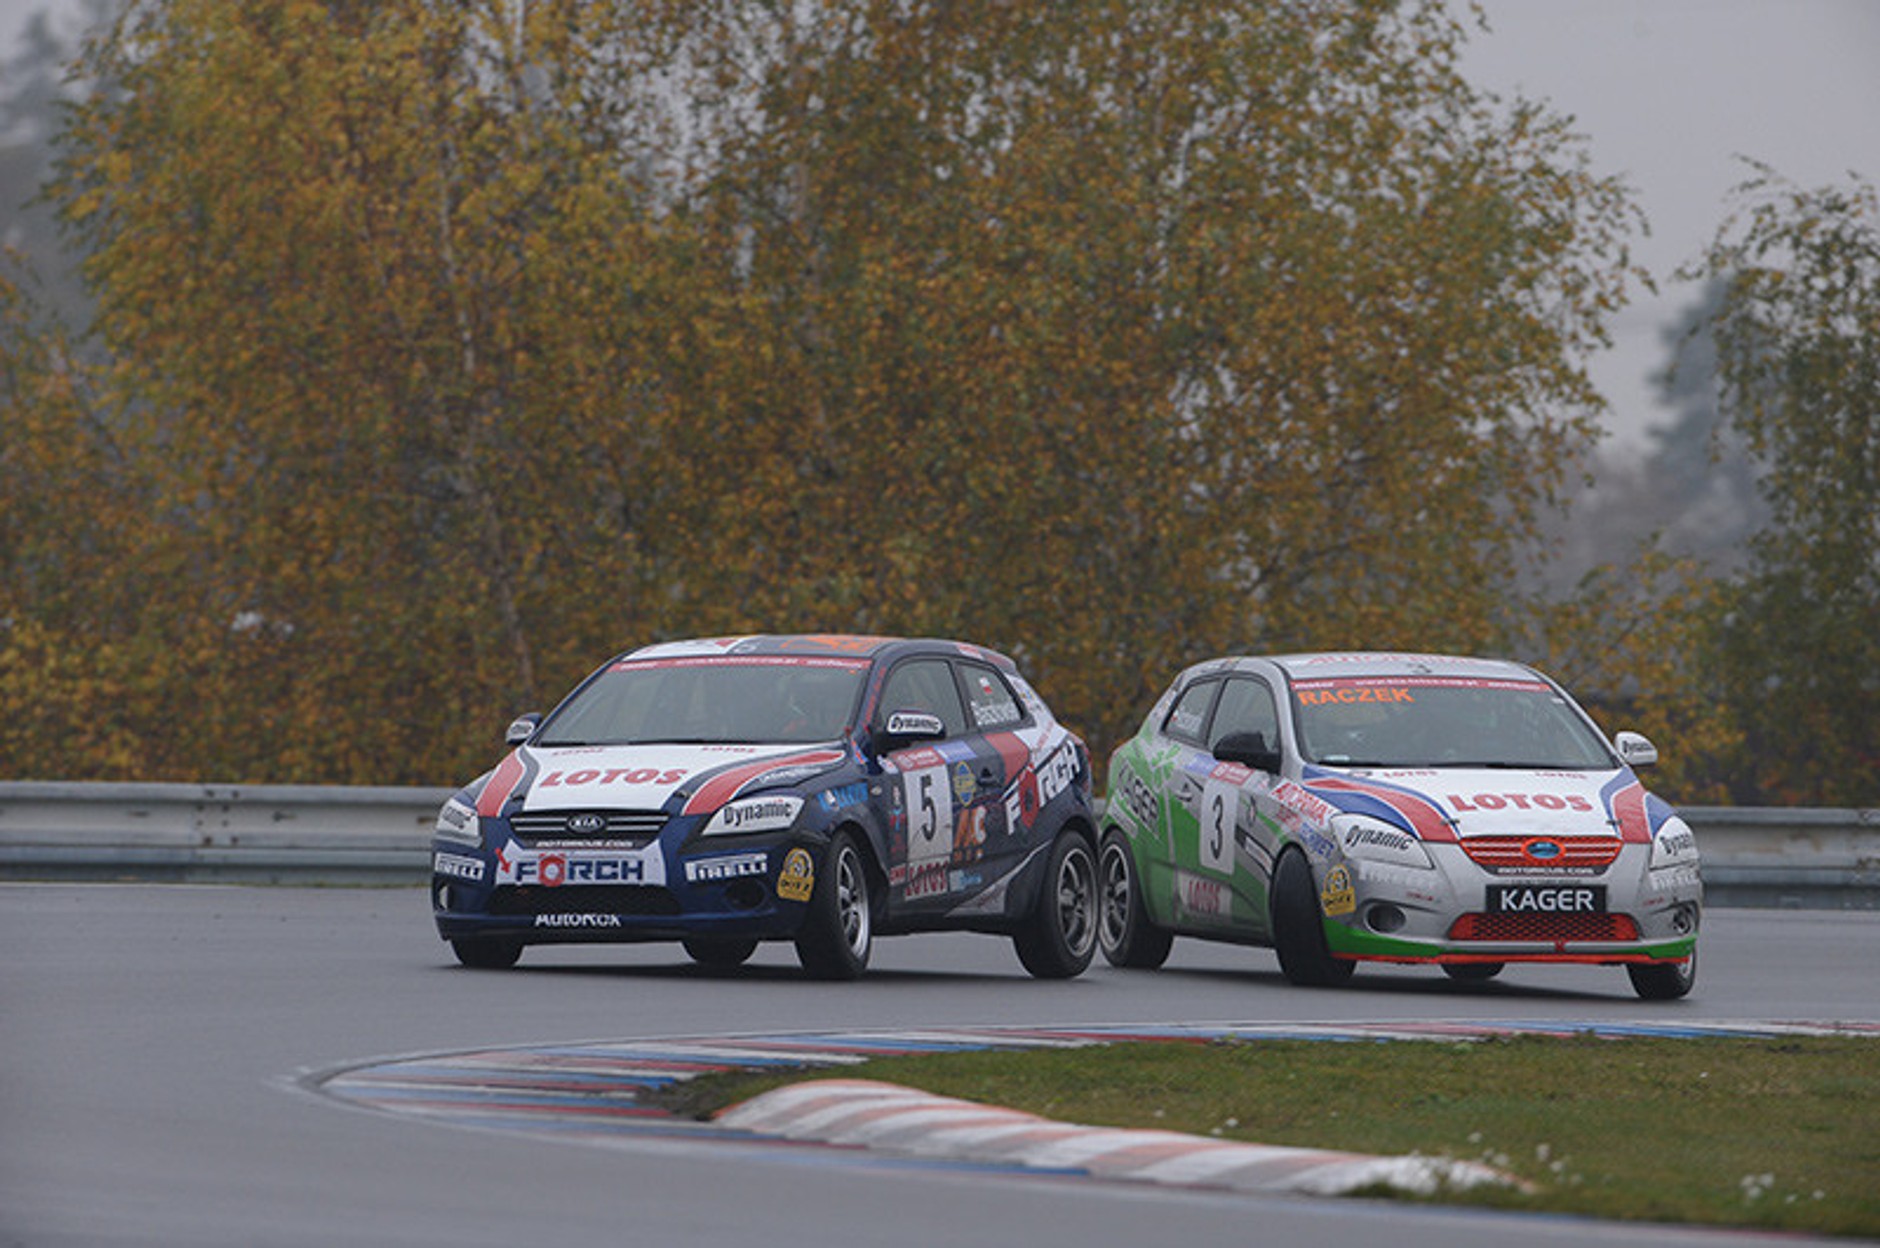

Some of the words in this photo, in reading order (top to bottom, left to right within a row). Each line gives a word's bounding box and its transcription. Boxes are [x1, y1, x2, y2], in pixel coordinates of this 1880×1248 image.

[1297, 686, 1415, 707] RACZEK
[539, 769, 688, 788] LOTOS
[723, 801, 793, 827] Dynamic
[920, 774, 937, 842] 5
[1447, 793, 1594, 812] LOTOS
[1210, 794, 1224, 861] 3
[1345, 825, 1413, 850] Dynamic
[684, 853, 768, 882] PIRELLI
[1500, 889, 1595, 911] KAGER
